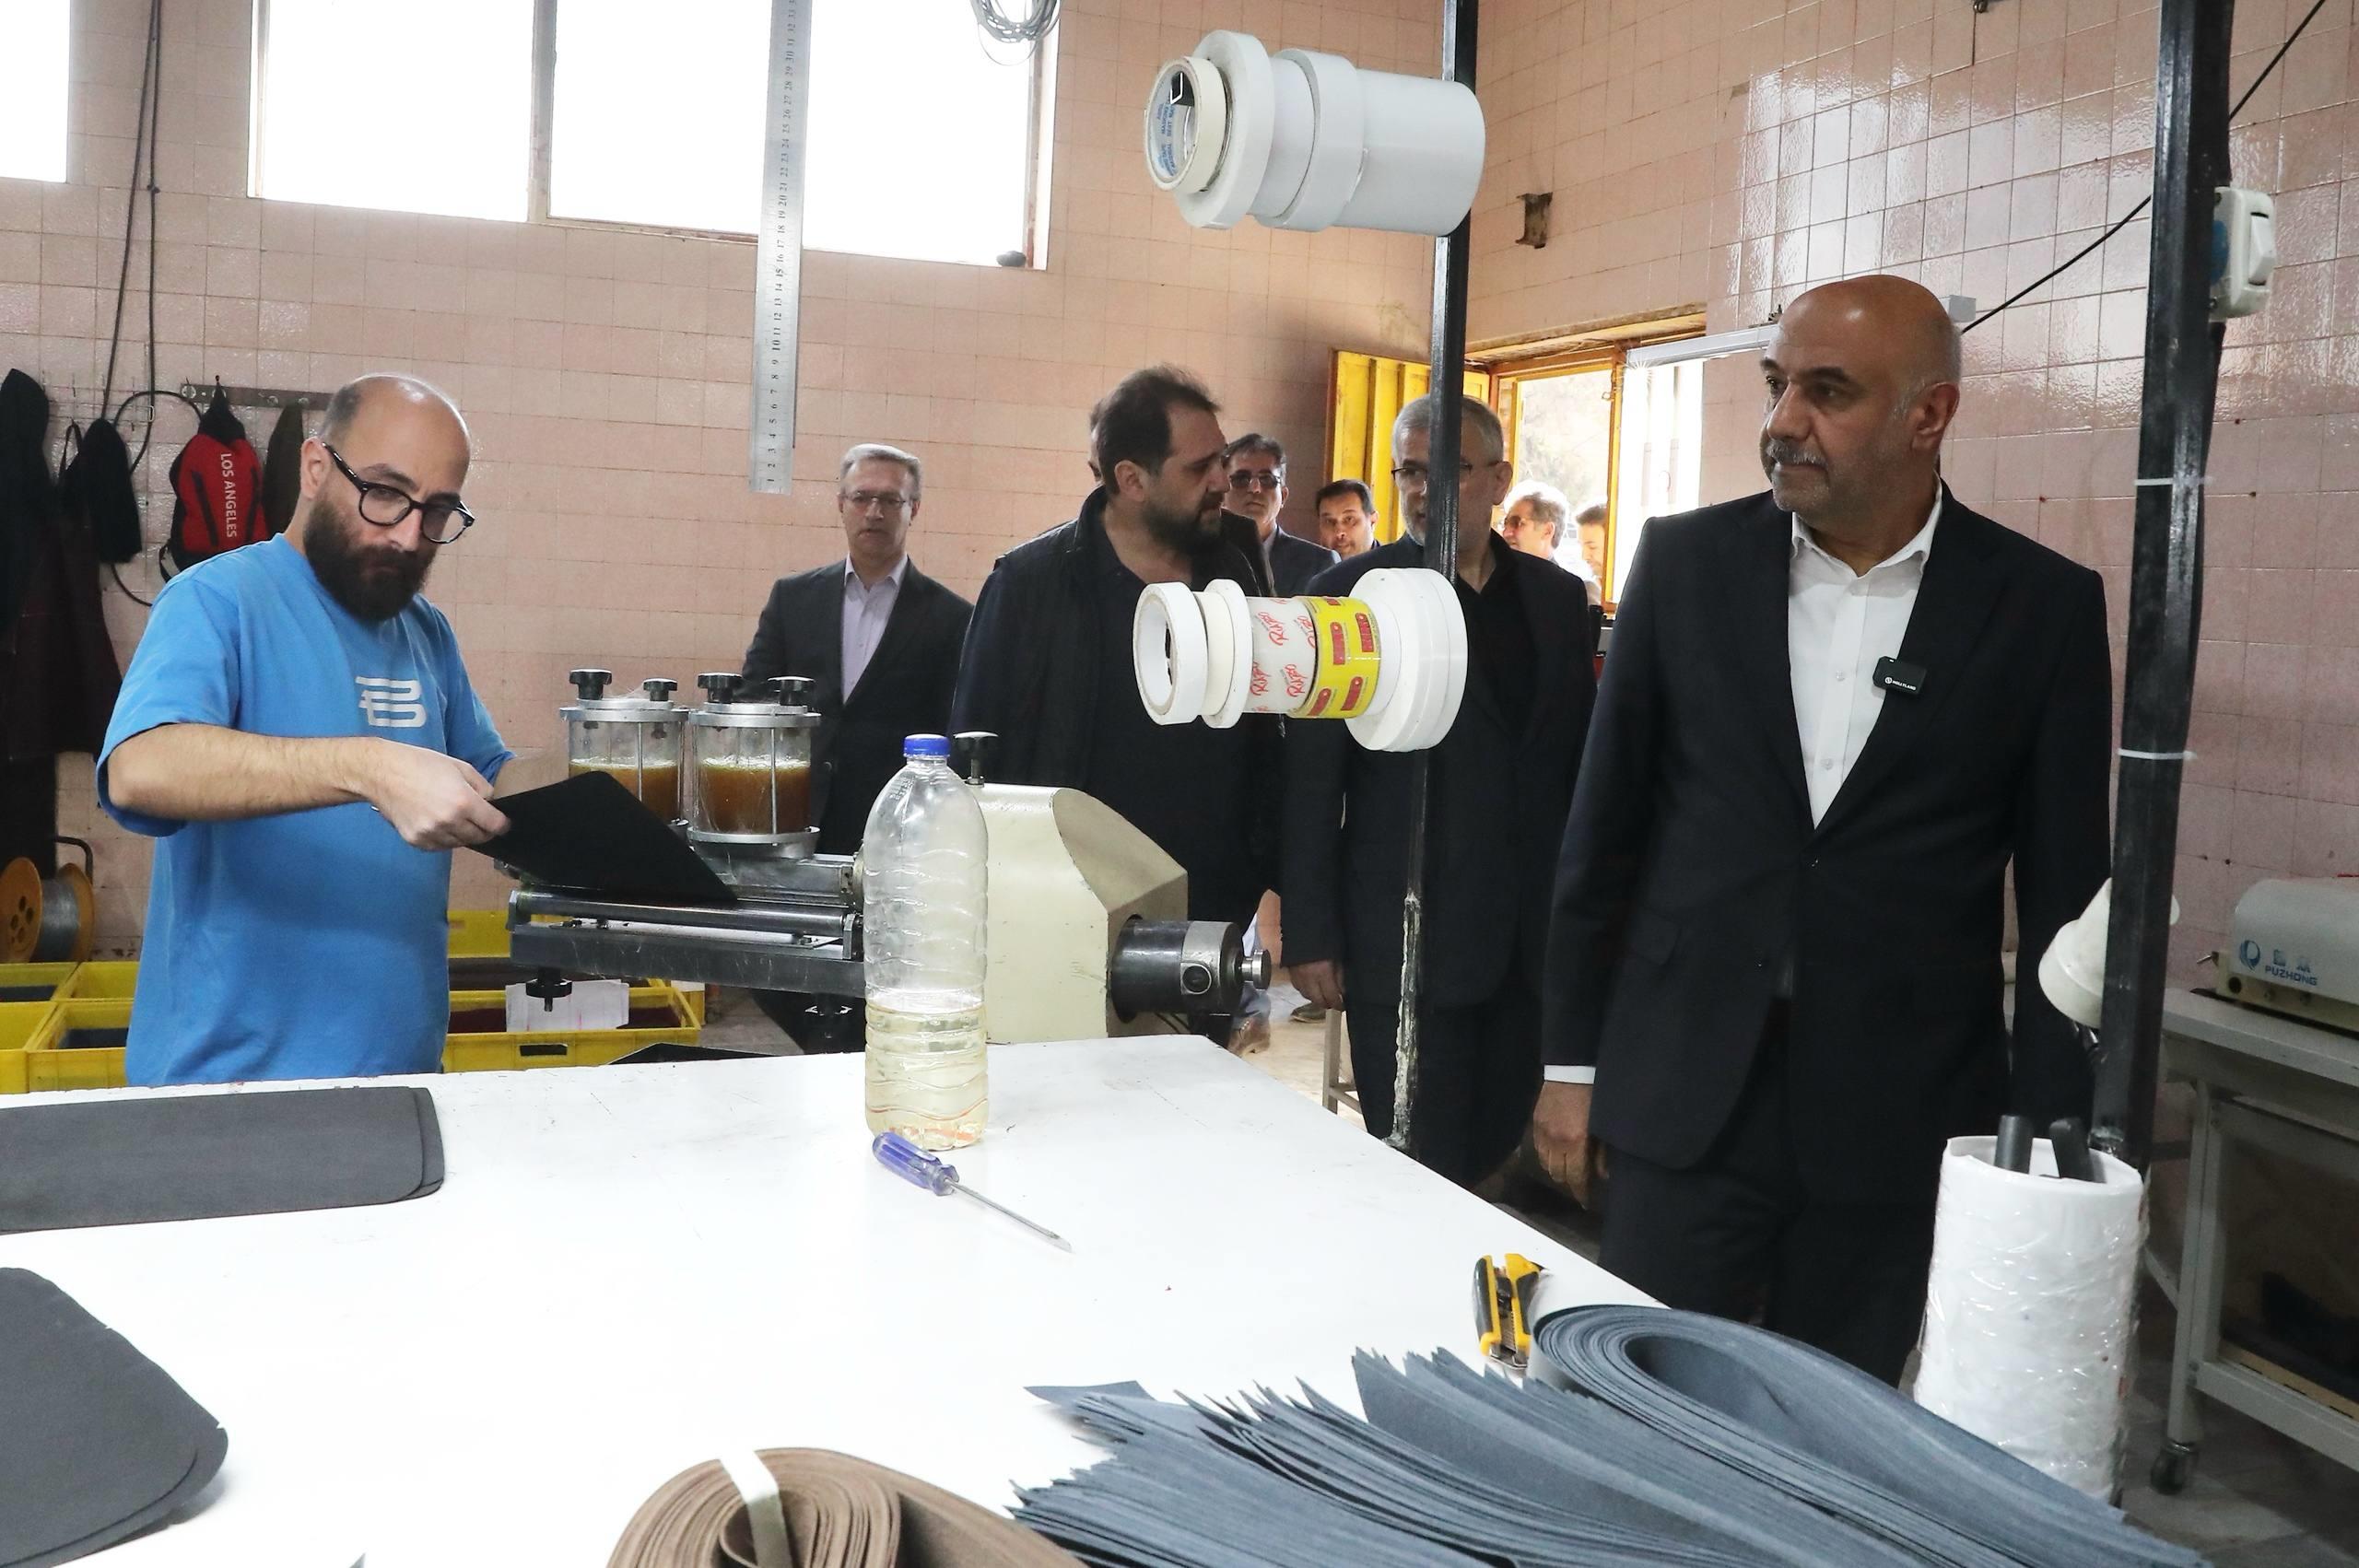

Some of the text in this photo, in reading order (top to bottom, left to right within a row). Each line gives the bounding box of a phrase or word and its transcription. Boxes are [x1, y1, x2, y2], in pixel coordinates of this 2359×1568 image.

[785, 51, 794, 63] 30
[783, 95, 792, 105] 27
[782, 109, 791, 119] 26
[781, 138, 790, 148] 24
[780, 182, 788, 192] 21
[778, 194, 787, 206] 20
[778, 210, 786, 218] 19
[777, 224, 785, 233] 18
[777, 239, 784, 248] 17
[777, 253, 784, 263] 16
[775, 268, 783, 277] 15
[775, 283, 782, 291] 14
[774, 298, 782, 306] 13
[774, 312, 781, 321] 12
[773, 327, 781, 335] 11
[771, 339, 781, 351] 10
[220, 453, 238, 538] LOS ANGELES
[2265, 965, 2318, 986] PUZHONG
